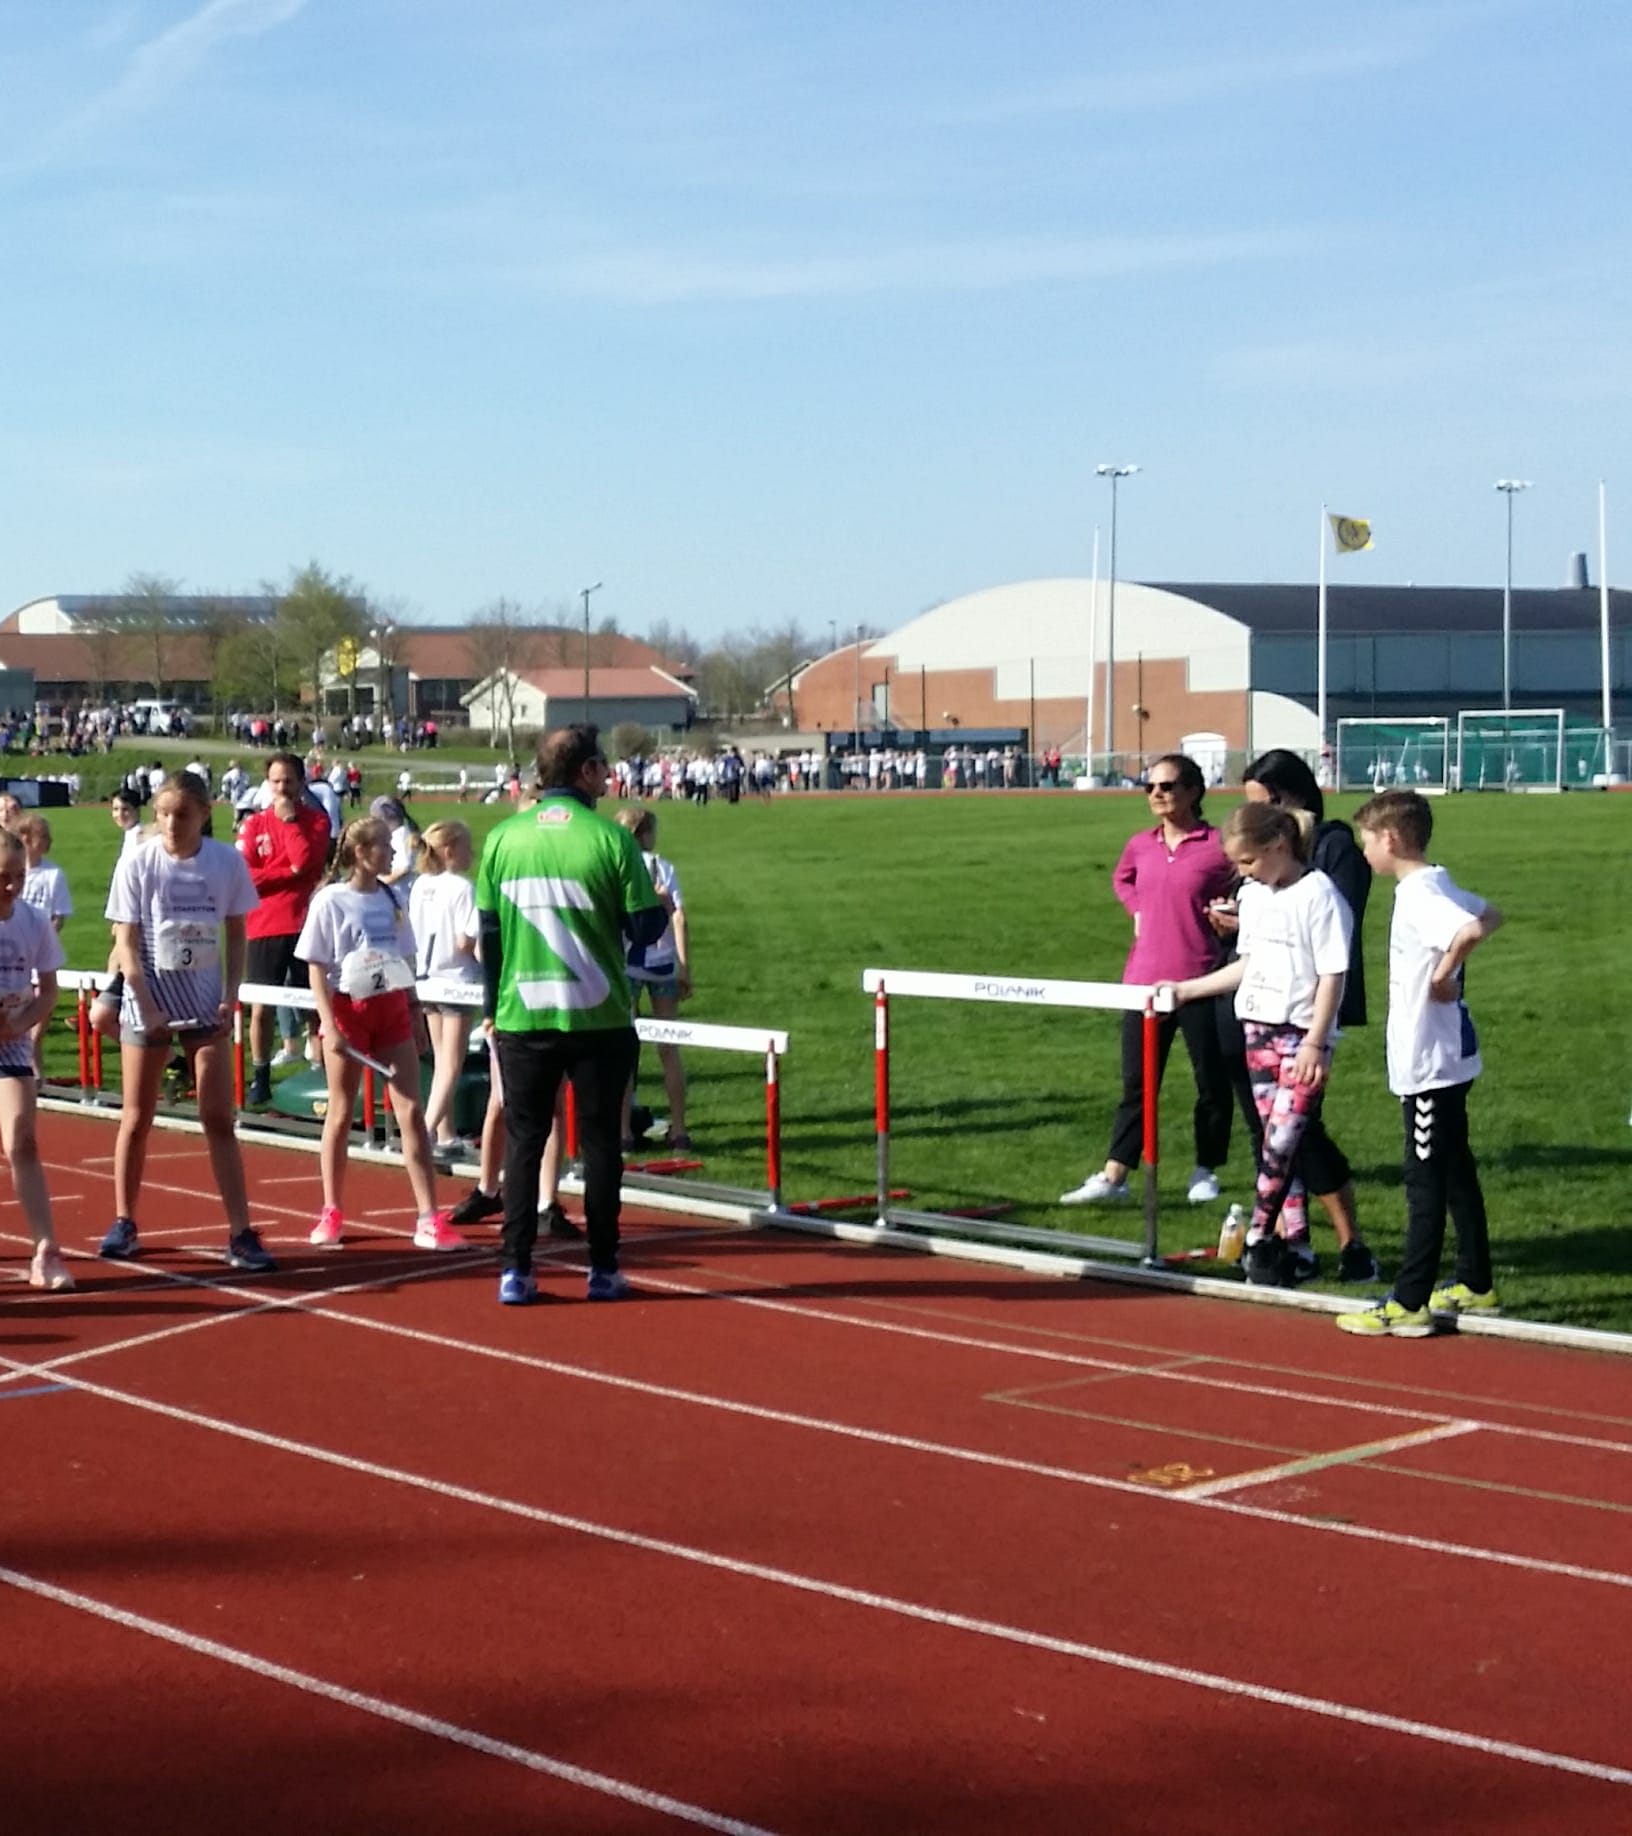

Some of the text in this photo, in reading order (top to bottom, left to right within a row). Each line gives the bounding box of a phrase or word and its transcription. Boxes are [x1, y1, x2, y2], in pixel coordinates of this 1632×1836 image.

[182, 948, 193, 966] 3
[371, 973, 385, 990] 2
[974, 982, 1046, 999] POLANIK
